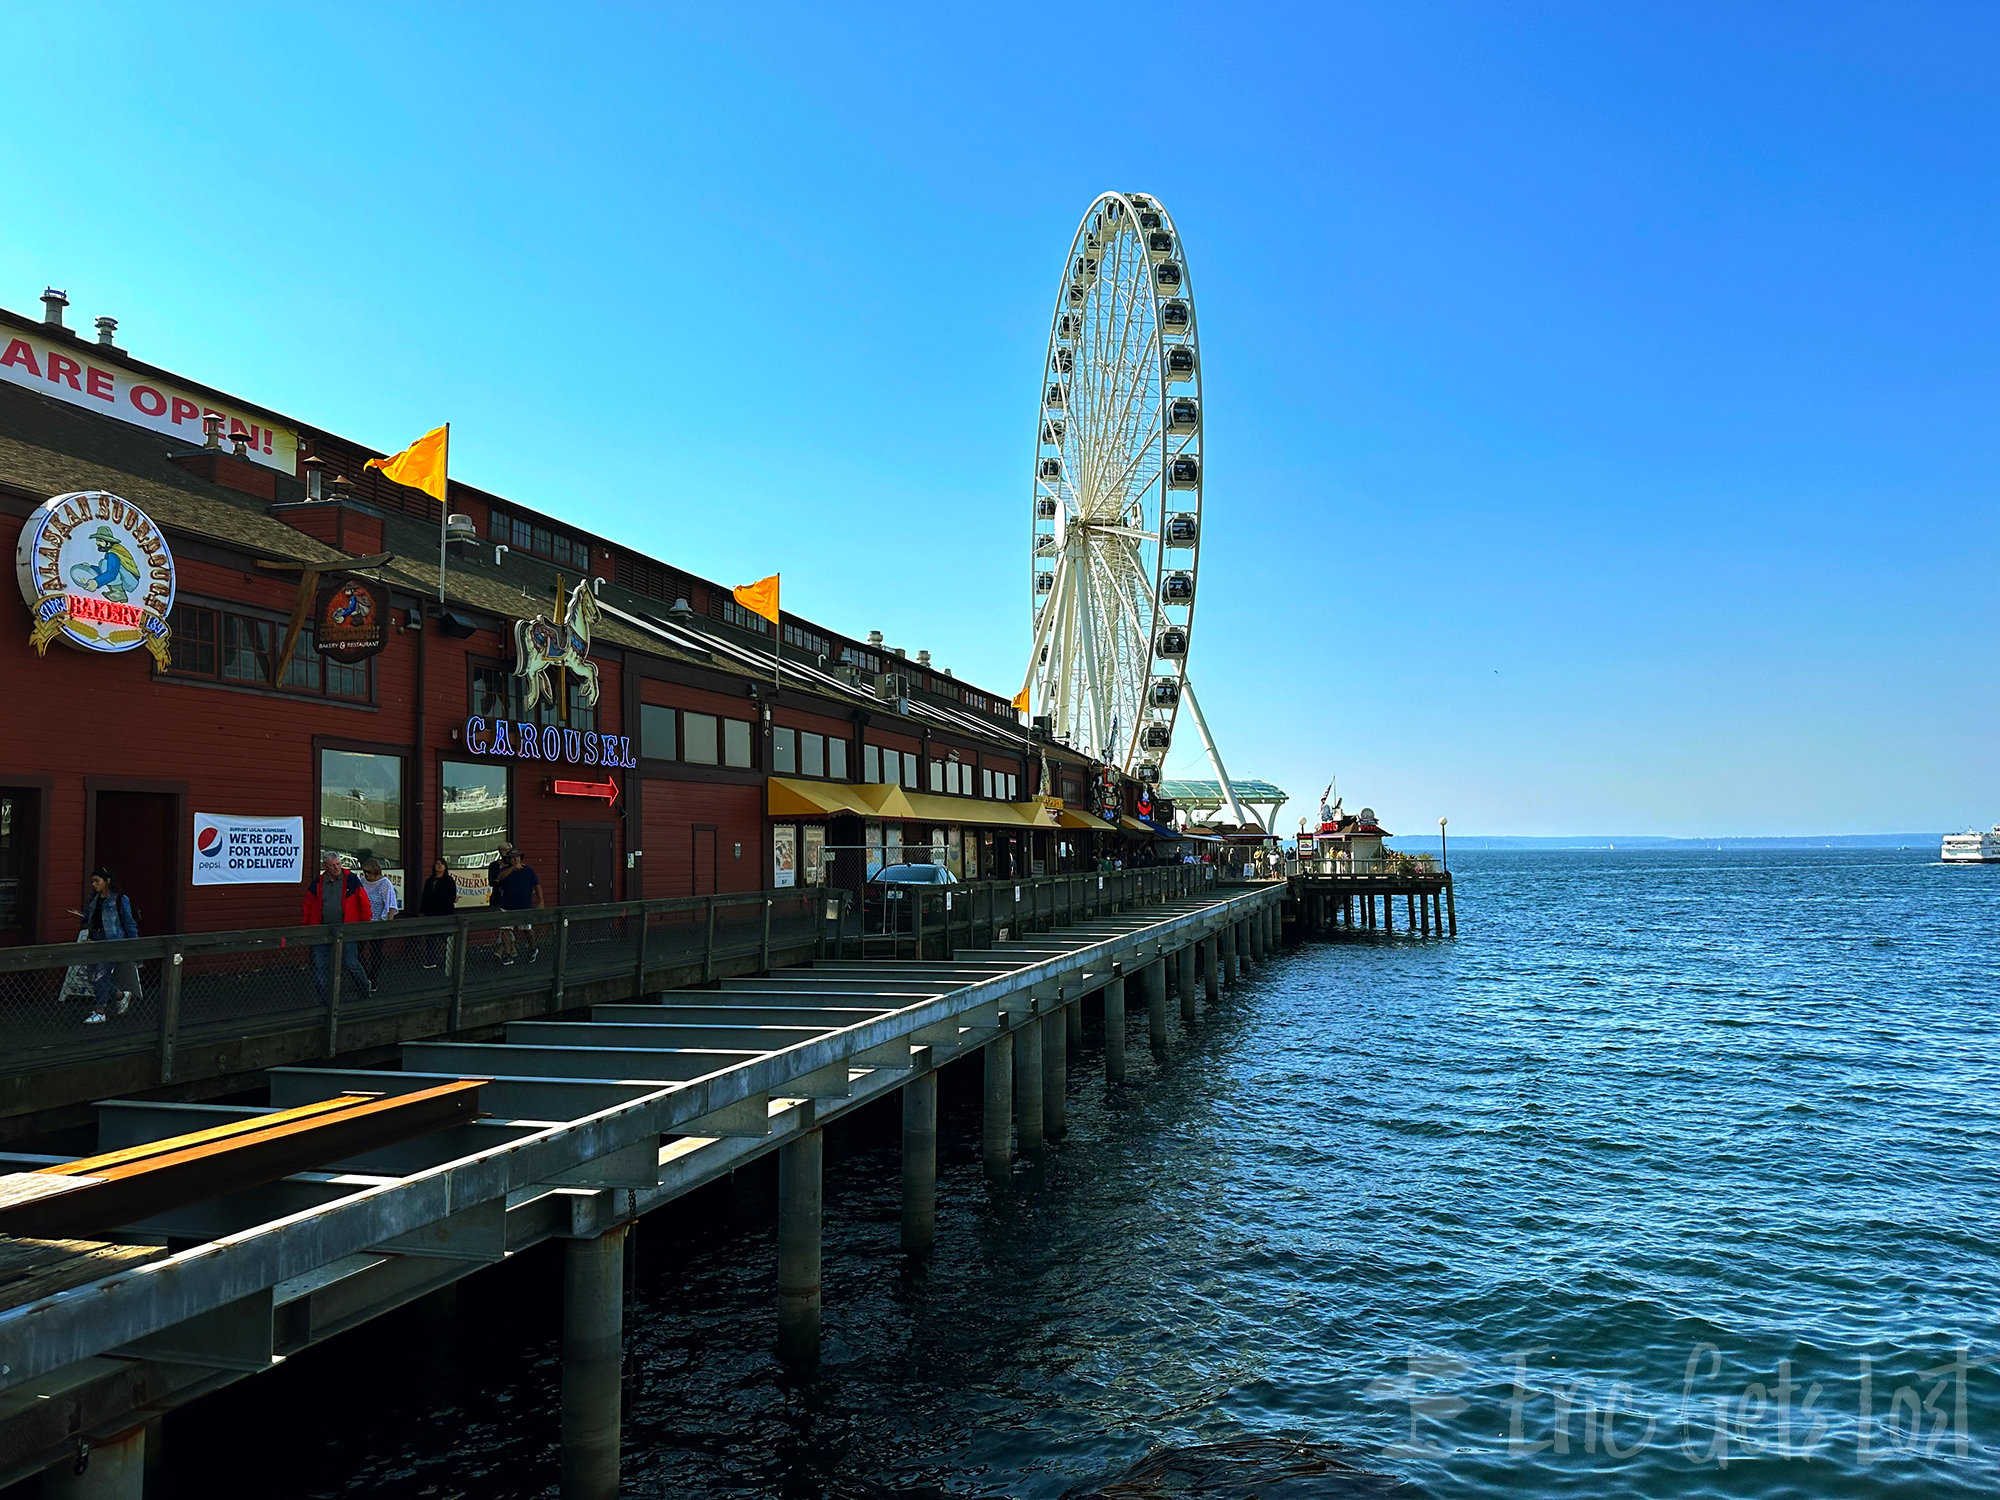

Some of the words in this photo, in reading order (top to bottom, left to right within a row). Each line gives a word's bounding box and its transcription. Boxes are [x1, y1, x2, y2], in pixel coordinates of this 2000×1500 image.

[0, 338, 115, 403] ARE
[129, 385, 273, 456] OPEN!
[38, 495, 93, 592] ALASKAN
[95, 494, 171, 614] SOURDOUGH
[39, 597, 68, 621] SINCE
[68, 594, 144, 627] BAKERY
[339, 641, 346, 650] &
[466, 715, 637, 769] CAROUSEL
[229, 833, 263, 844] WE'RE
[264, 834, 293, 845] OPEN
[229, 846, 251, 856] FOR
[253, 846, 300, 857] TAKEOUT
[198, 860, 221, 871] pepsi
[228, 858, 245, 869] OR
[246, 858, 295, 869] DELIVERY
